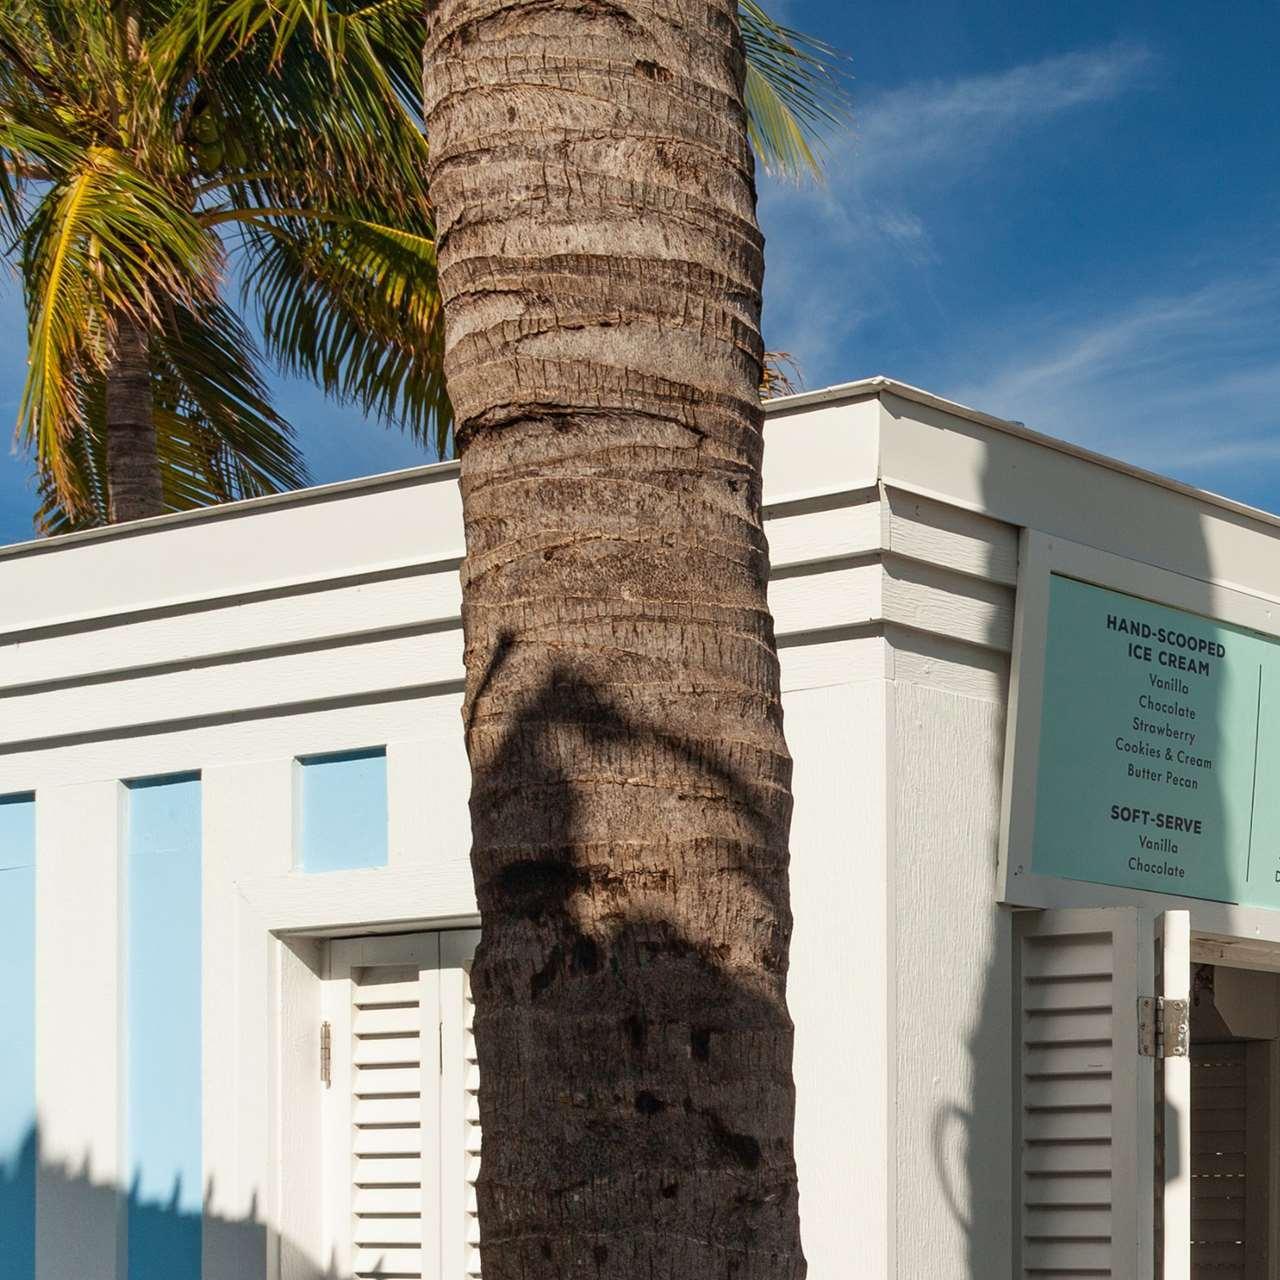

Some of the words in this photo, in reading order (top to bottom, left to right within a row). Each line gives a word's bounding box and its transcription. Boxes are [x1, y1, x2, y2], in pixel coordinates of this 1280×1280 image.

[1107, 614, 1226, 658] HAND-SCOOPED
[1128, 643, 1153, 662] ICE
[1158, 651, 1210, 676] CREAM
[1149, 673, 1189, 695] Vanilla
[1138, 695, 1196, 720] Chocolate
[1132, 717, 1196, 746] Strawberry
[1115, 737, 1161, 758] Cookies
[1164, 747, 1174, 762] &
[1177, 750, 1212, 769] Cream
[1128, 763, 1162, 782] Butter
[1166, 771, 1199, 790] Pecan
[1111, 805, 1202, 834] SOFT-SERVE
[1139, 835, 1179, 854] Vanilla
[1128, 857, 1185, 878] Chocolate
